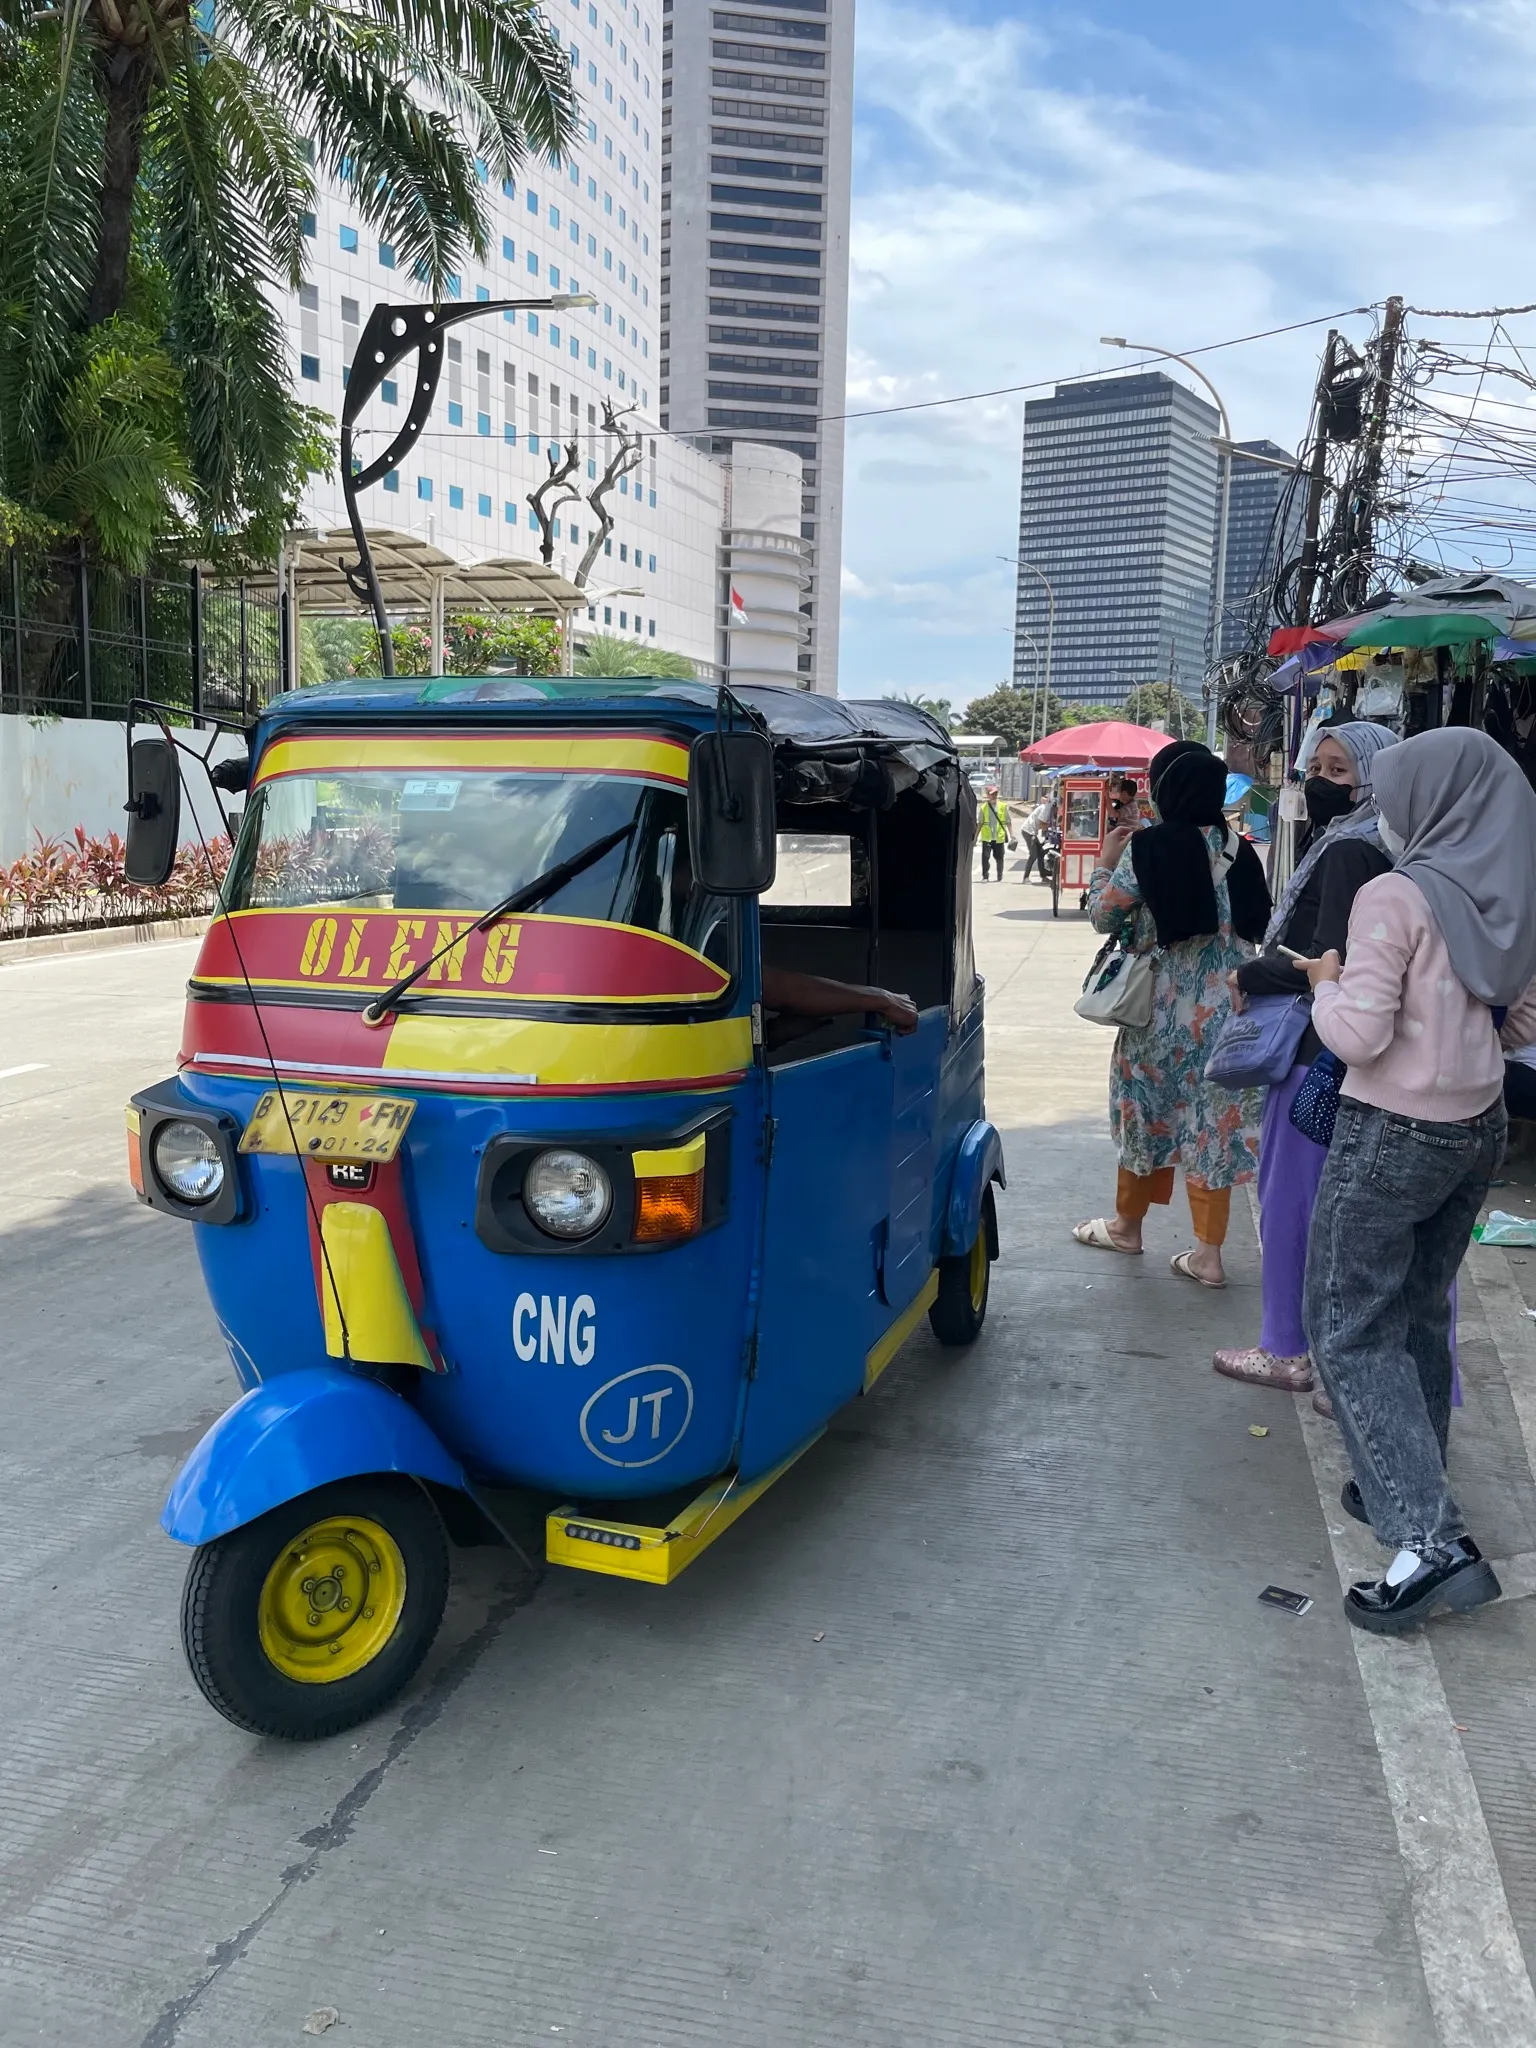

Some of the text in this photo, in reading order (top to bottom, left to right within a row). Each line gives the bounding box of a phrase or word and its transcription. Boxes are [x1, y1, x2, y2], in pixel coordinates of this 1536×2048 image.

[299, 917, 523, 985] OLENG
[255, 1095, 275, 1119] B
[371, 1102, 411, 1130] FN
[512, 1292, 596, 1366] CNG
[601, 1387, 673, 1444] JT
